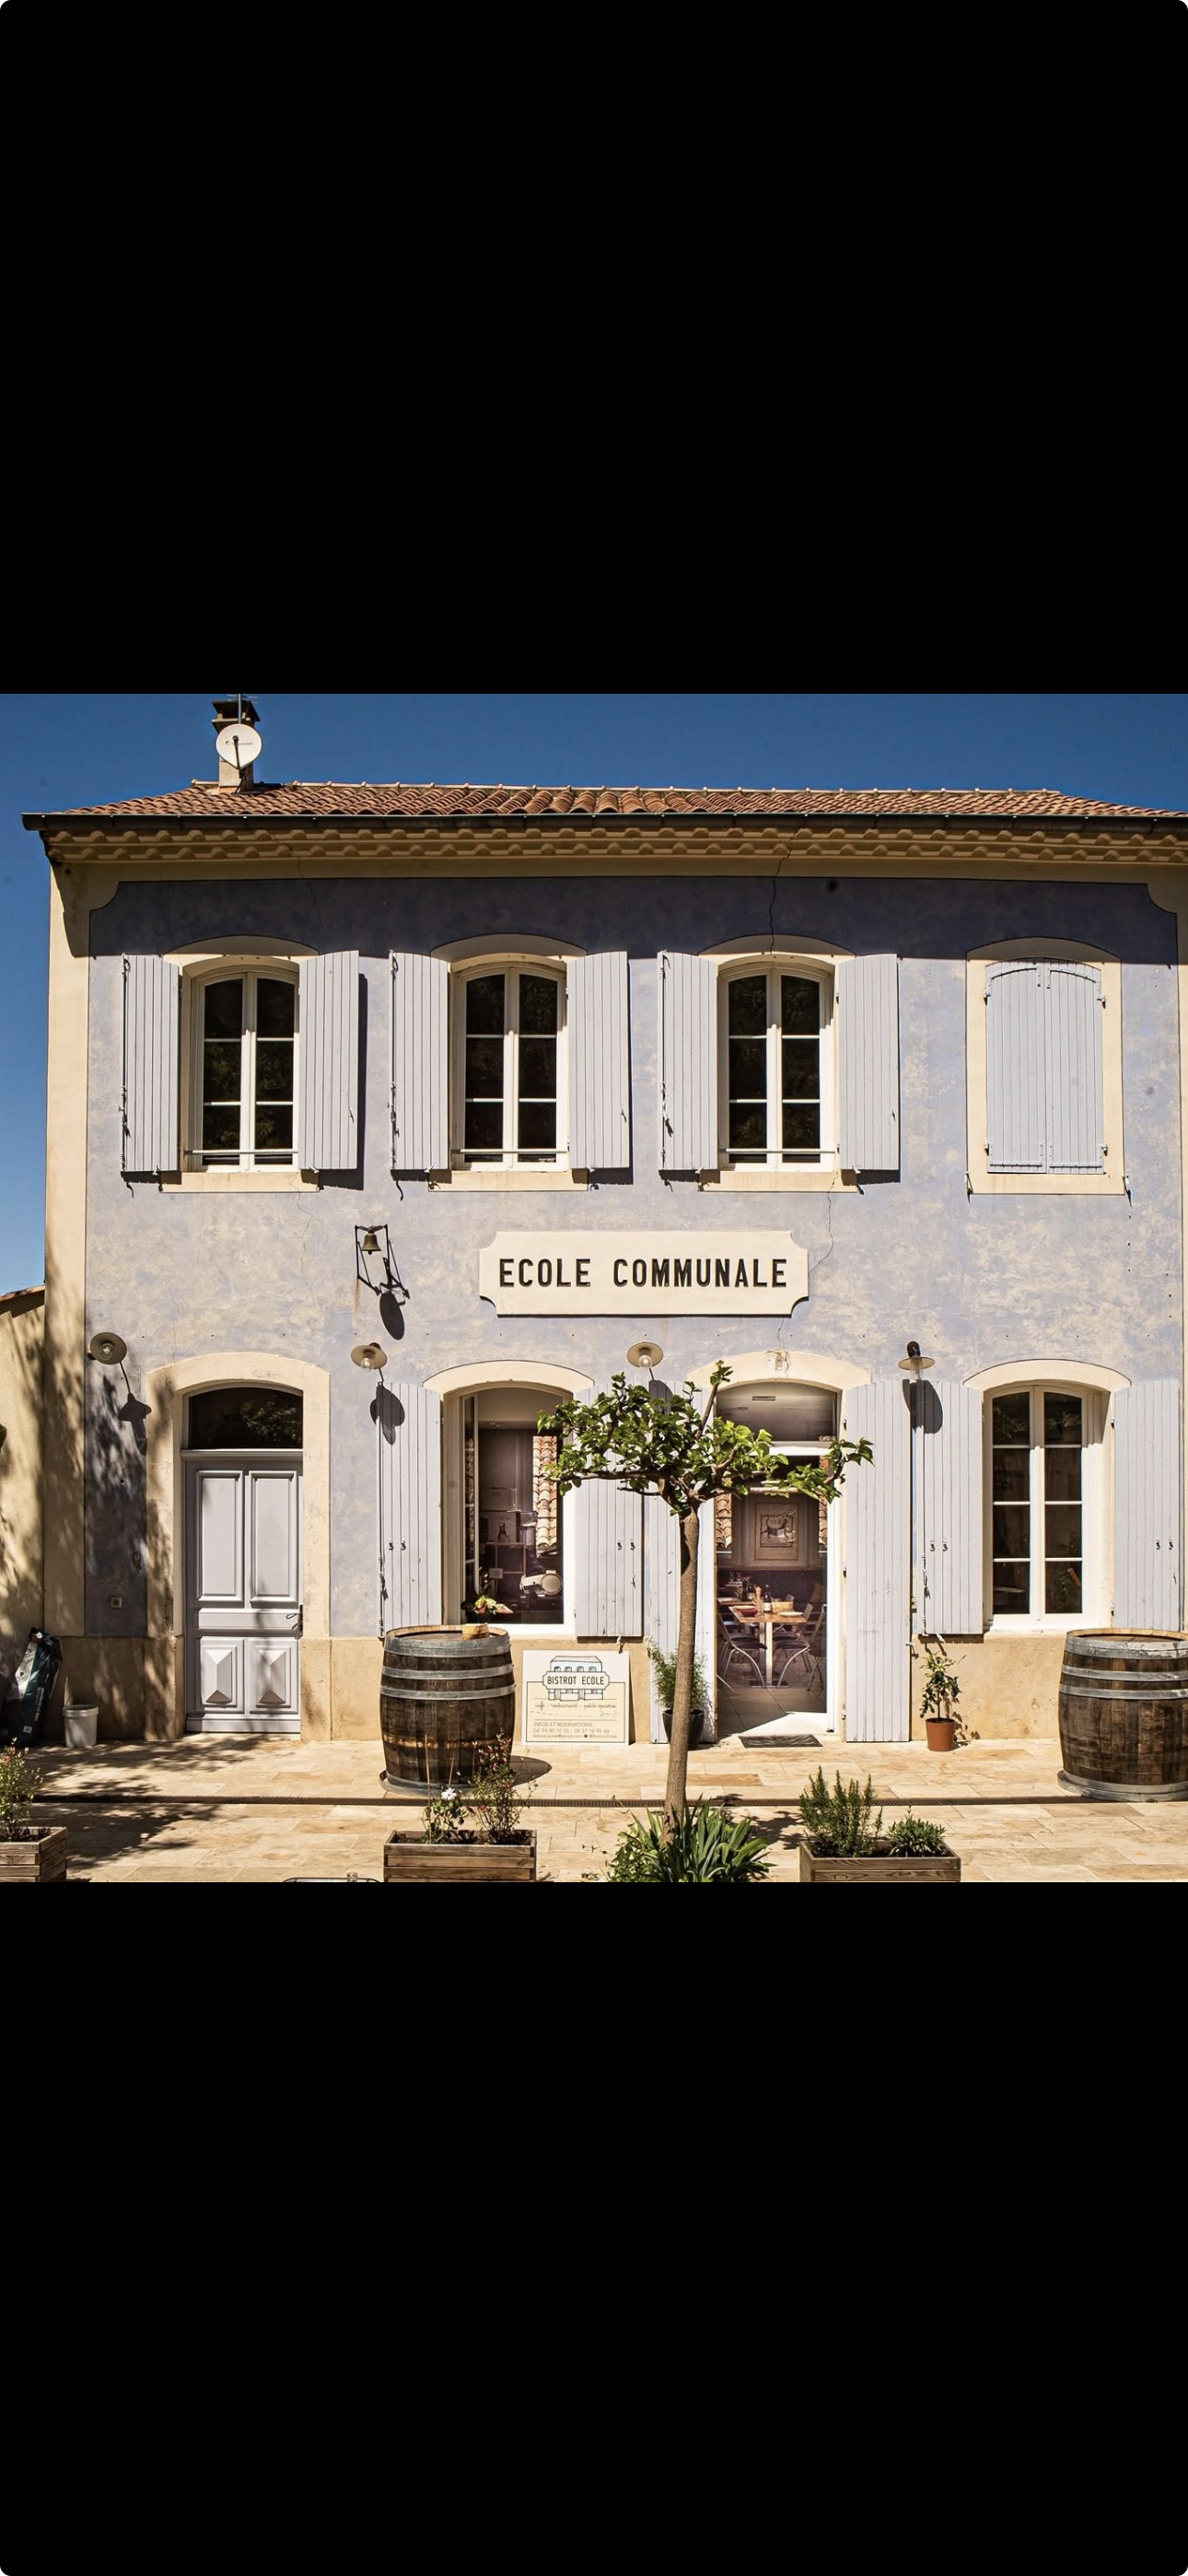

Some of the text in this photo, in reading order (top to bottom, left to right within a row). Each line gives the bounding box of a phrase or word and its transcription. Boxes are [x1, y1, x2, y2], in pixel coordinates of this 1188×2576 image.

[499, 1259, 787, 1288] ECOLE COMMUNALE
[547, 1676, 605, 1685] BISTROT ECOLE
